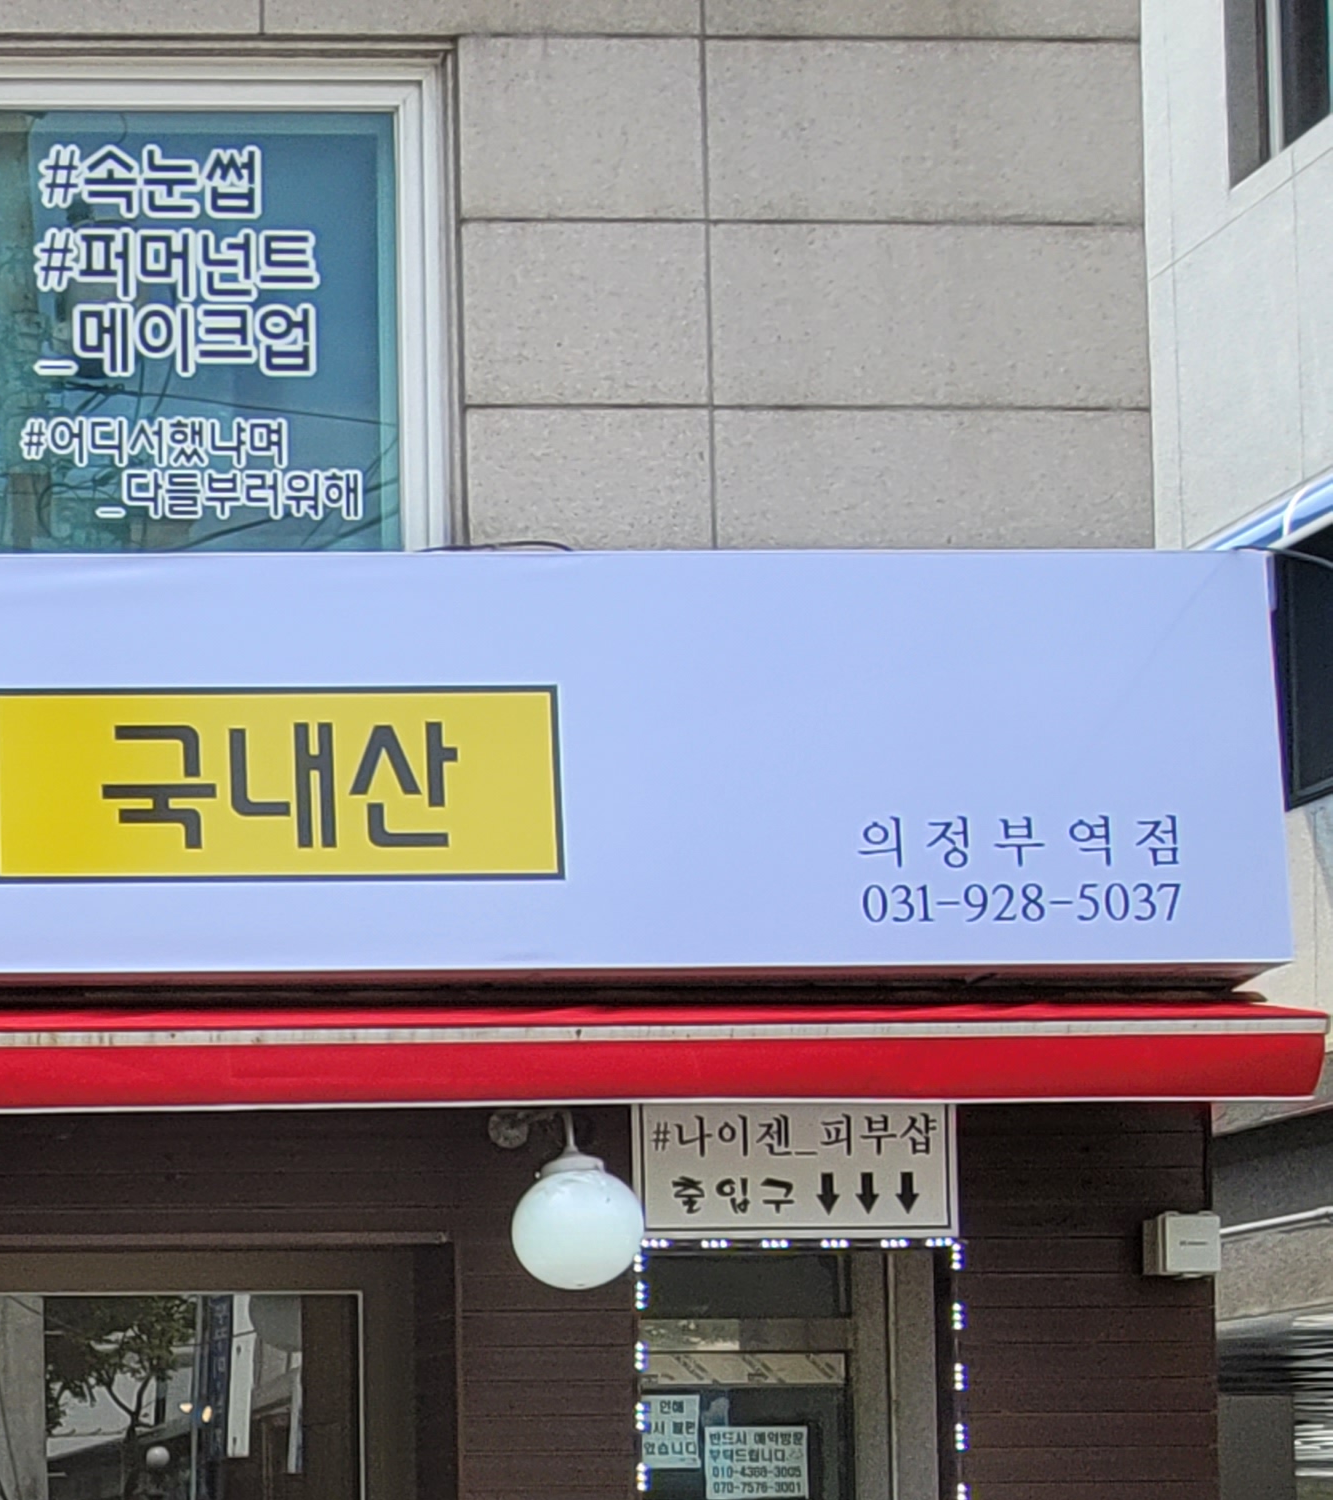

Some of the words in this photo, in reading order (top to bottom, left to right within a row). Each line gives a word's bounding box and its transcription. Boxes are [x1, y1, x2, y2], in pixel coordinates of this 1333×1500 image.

[39, 144, 262, 219] #속눈썹
[34, 228, 321, 302] #퍼머넌트
[21, 416, 289, 469] #어디서했냐며
[100, 720, 459, 850] 국내산
[858, 814, 1184, 870] 의정부역점
[861, 881, 1182, 925] 031-928-5037
[672, 1176, 795, 1214] 출입구
[710, 1431, 747, 1446] 반드시
[713, 1482, 801, 1494] 070-7576-3001
